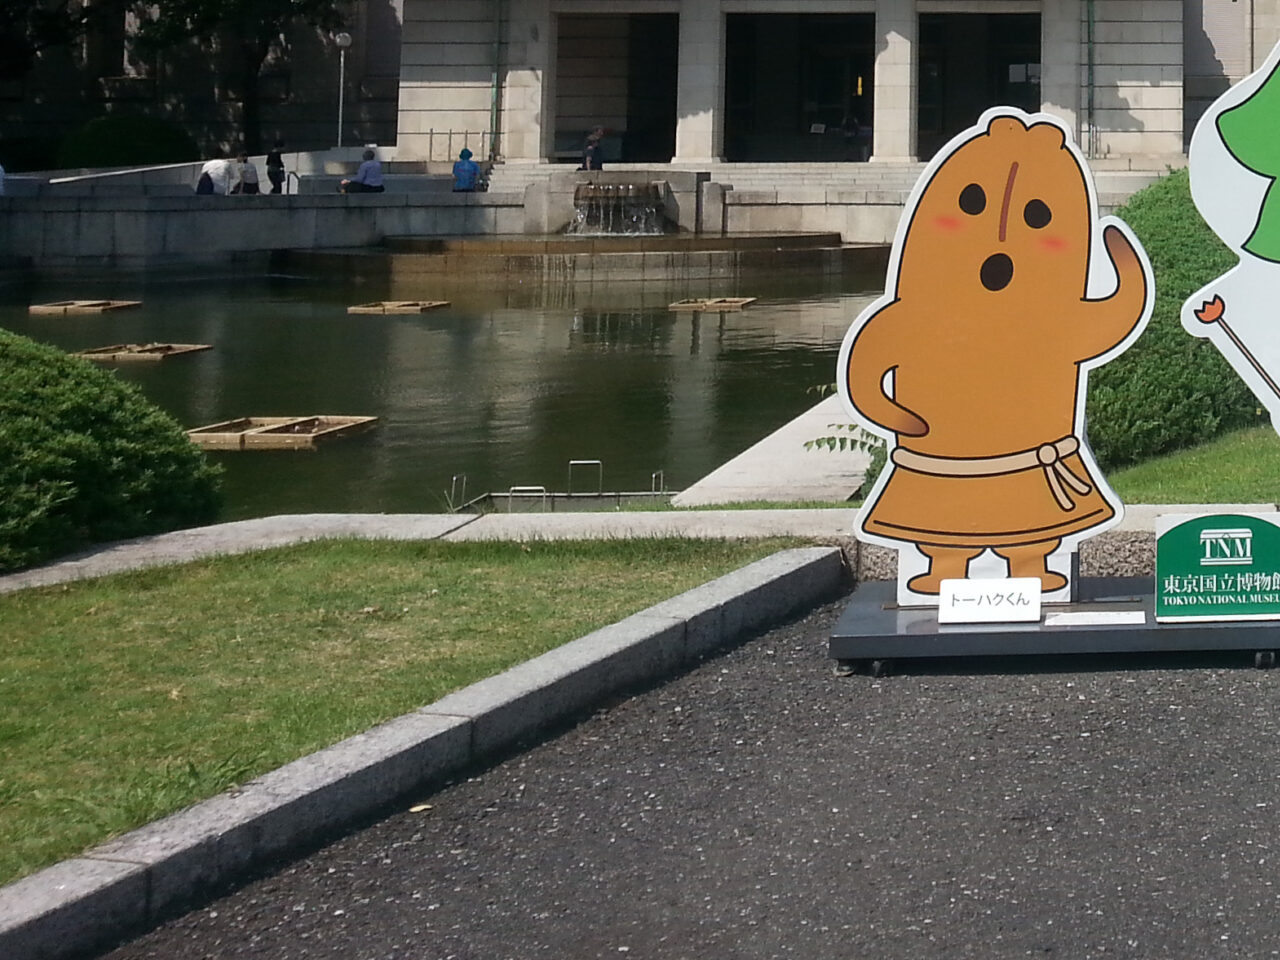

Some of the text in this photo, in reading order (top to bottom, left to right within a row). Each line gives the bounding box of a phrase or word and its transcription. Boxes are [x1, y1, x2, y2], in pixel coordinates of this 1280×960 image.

[1200, 538, 1252, 559] TNM
[951, 592, 1031, 607] トーハクくん
[1162, 595, 1197, 606] TOKYO
[1198, 593, 1248, 605] NATIONAL
